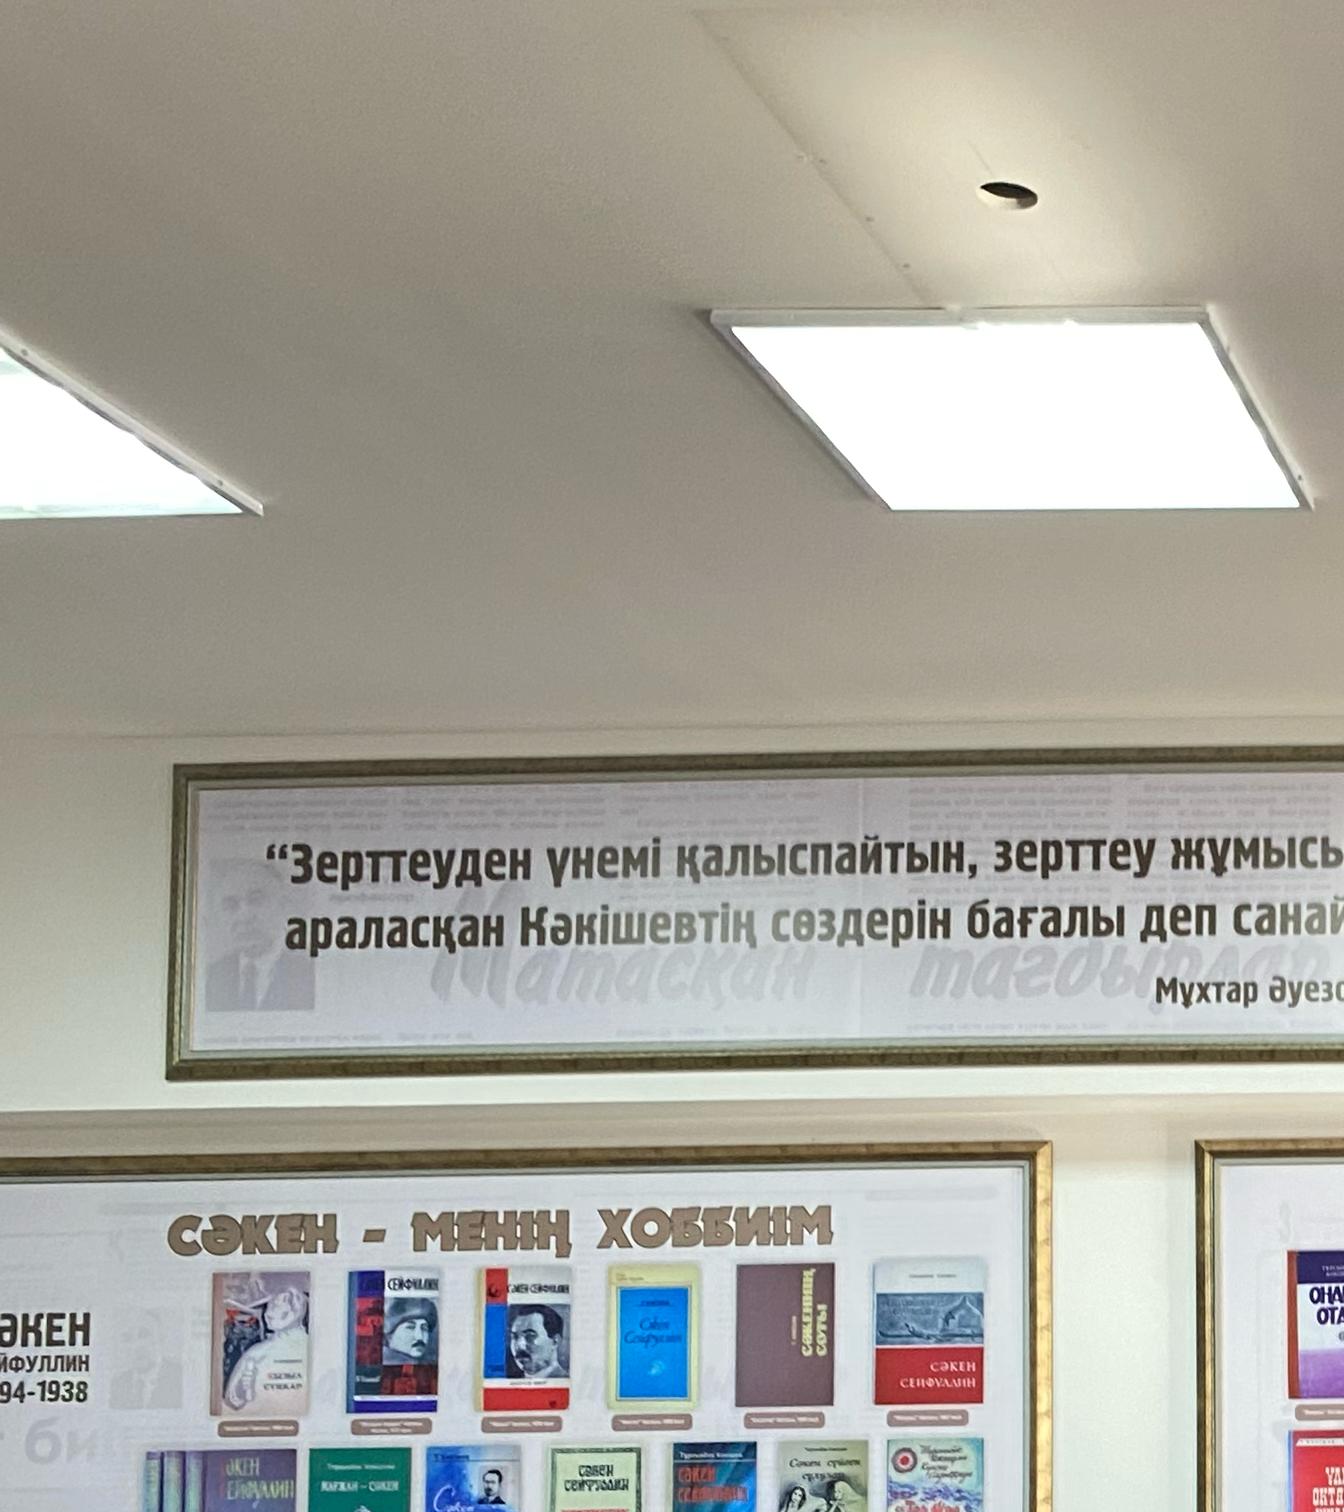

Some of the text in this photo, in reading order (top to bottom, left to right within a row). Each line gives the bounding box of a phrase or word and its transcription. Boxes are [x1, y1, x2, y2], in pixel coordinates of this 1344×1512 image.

[266, 843, 532, 889] “Зерттеуден
[547, 838, 662, 887] үнемі
[677, 835, 978, 884] қалыспайтын,
[994, 836, 1155, 878] зерттеу
[285, 912, 504, 956] араласқан
[521, 902, 757, 949] Кәкішевтің
[771, 900, 951, 947] сөздерін
[969, 900, 1125, 939] бағалы
[1140, 904, 1216, 941] деп
[1156, 976, 1257, 1007] Мұхтар
[168, 1212, 339, 1255] СӘКЕН
[411, 1208, 572, 1258] МЕНІҢ
[597, 1205, 833, 1249] ХОББИІМ
[0, 1312, 90, 1347] ӘКЕН
[0, 1353, 89, 1373] ЙФУЛЛИН
[0, 1380, 88, 1403] 94-1938
